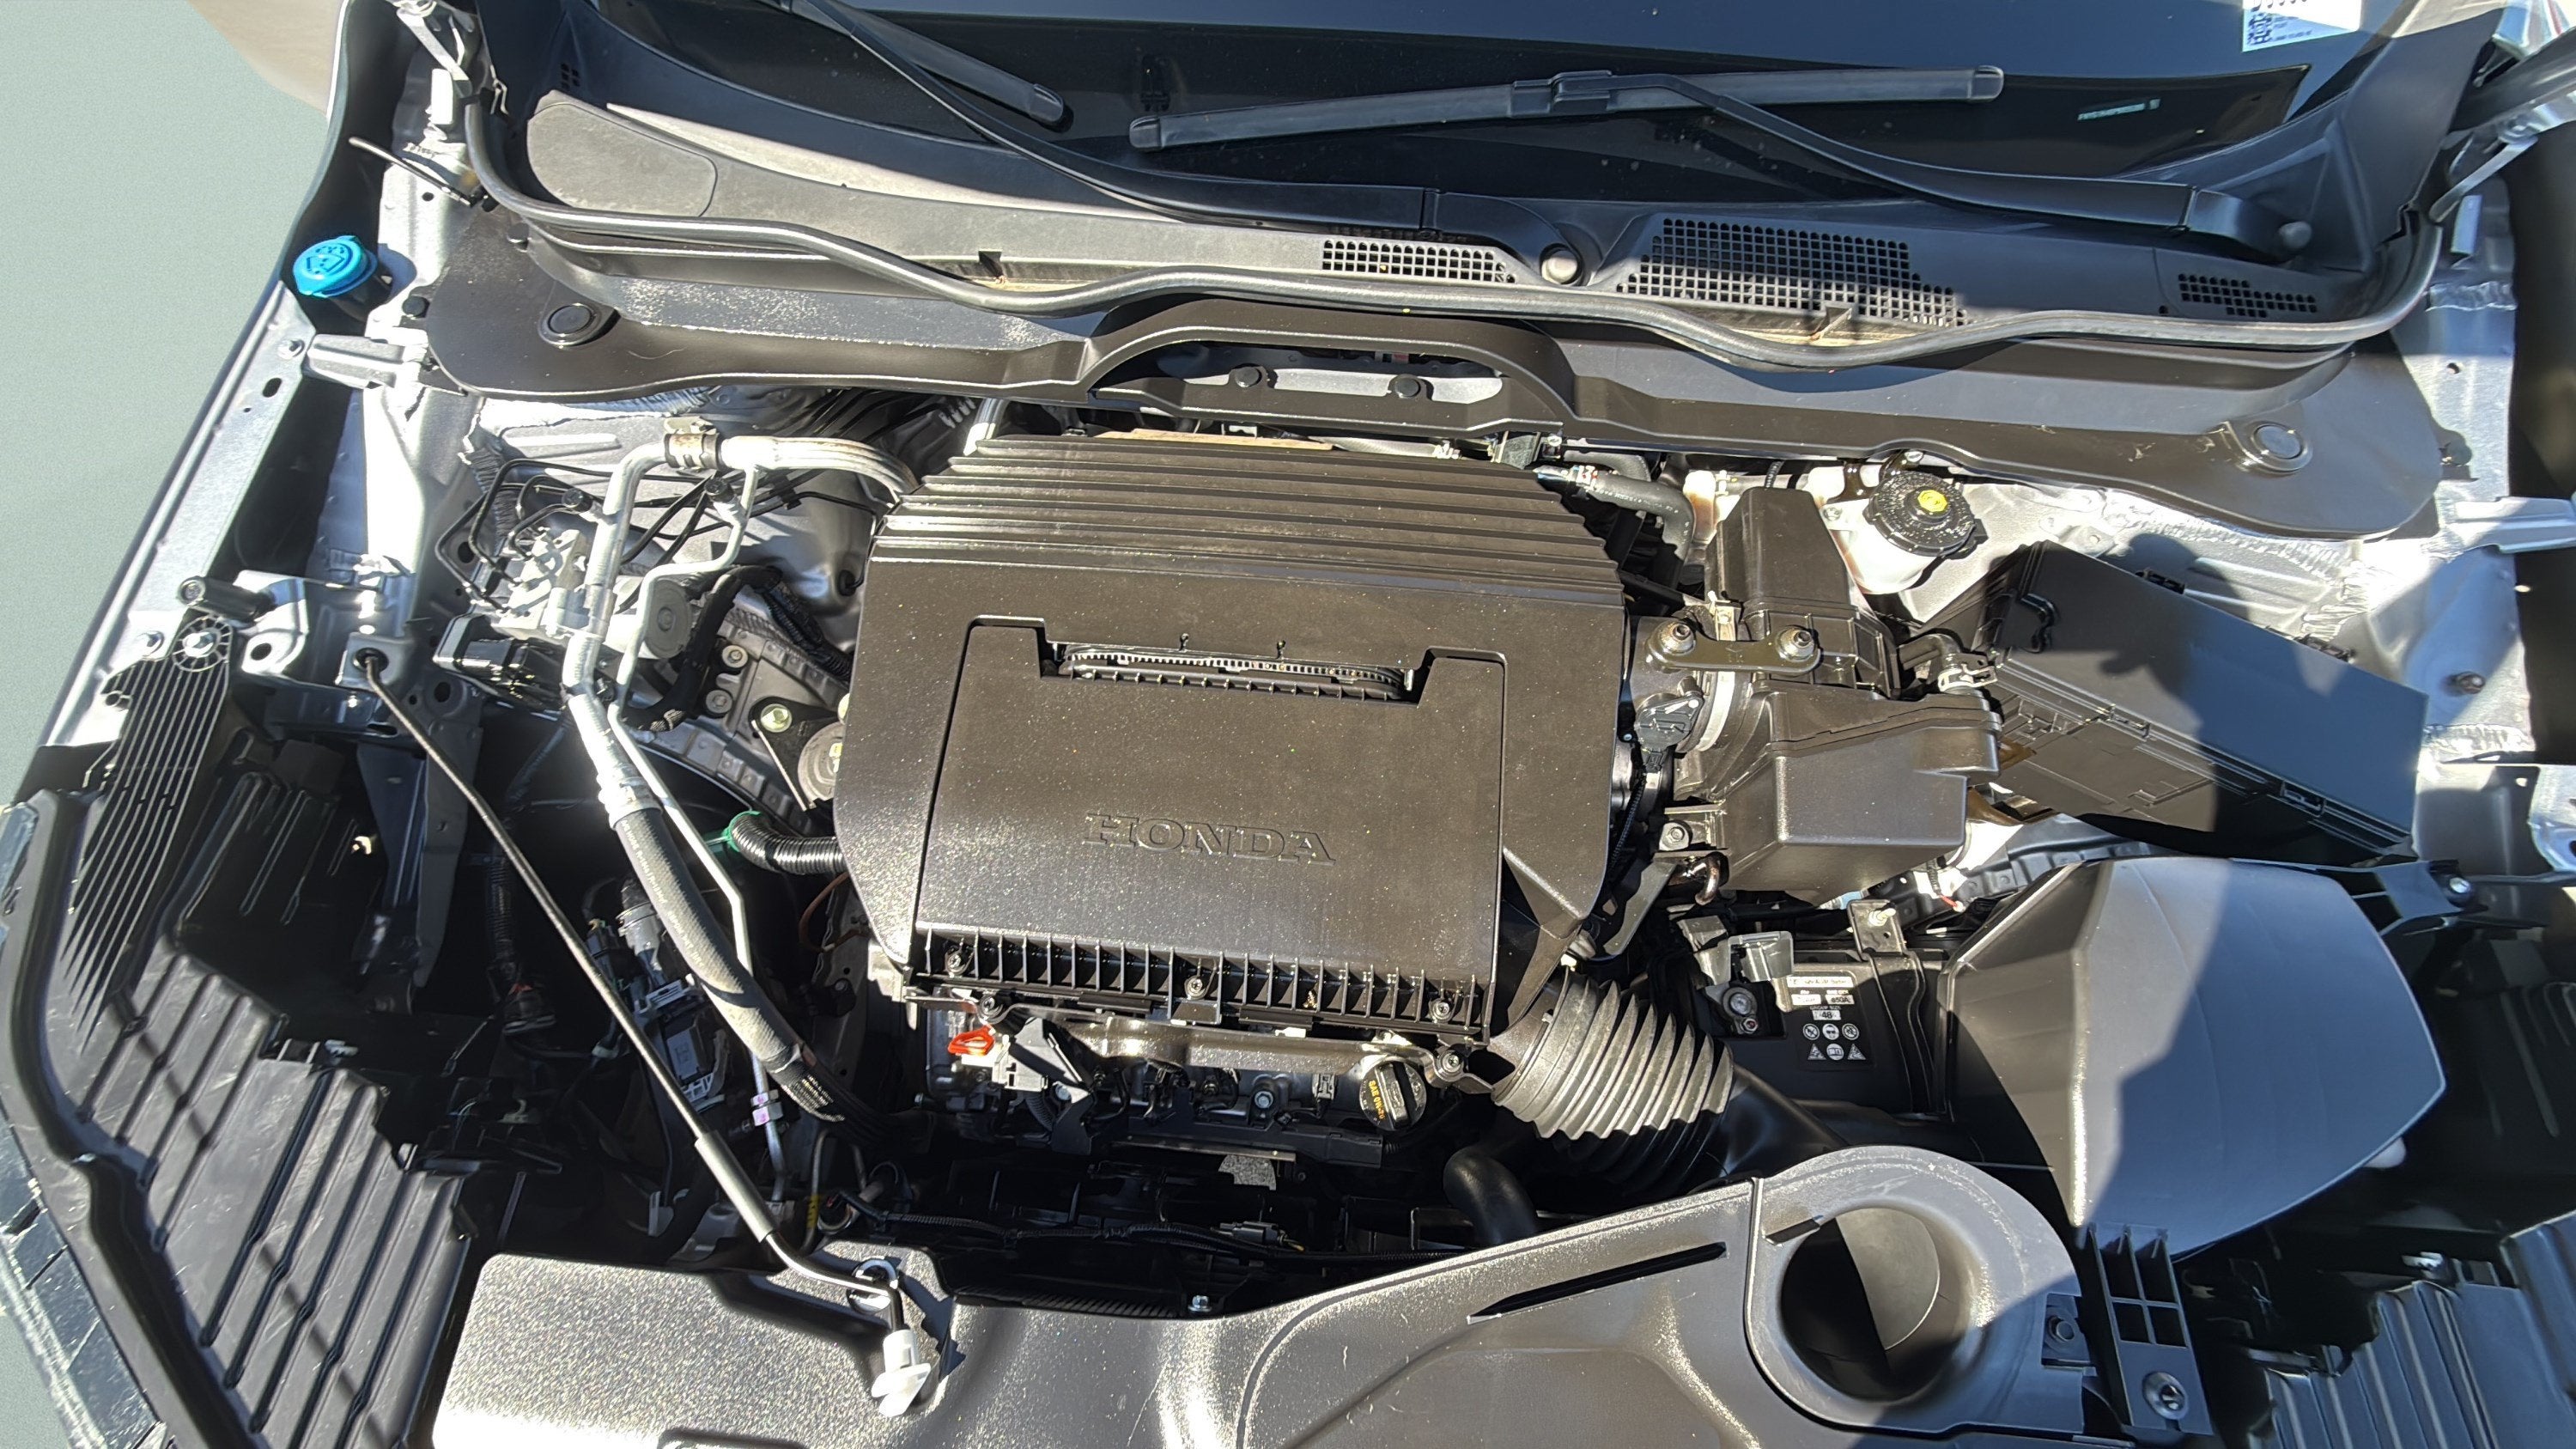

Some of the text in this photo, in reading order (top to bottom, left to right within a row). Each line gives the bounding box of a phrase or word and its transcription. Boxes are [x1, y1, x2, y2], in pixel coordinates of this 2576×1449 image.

[1082, 813, 1336, 866] HONDA
[1368, 1080, 1385, 1119] SAE 0W-20
